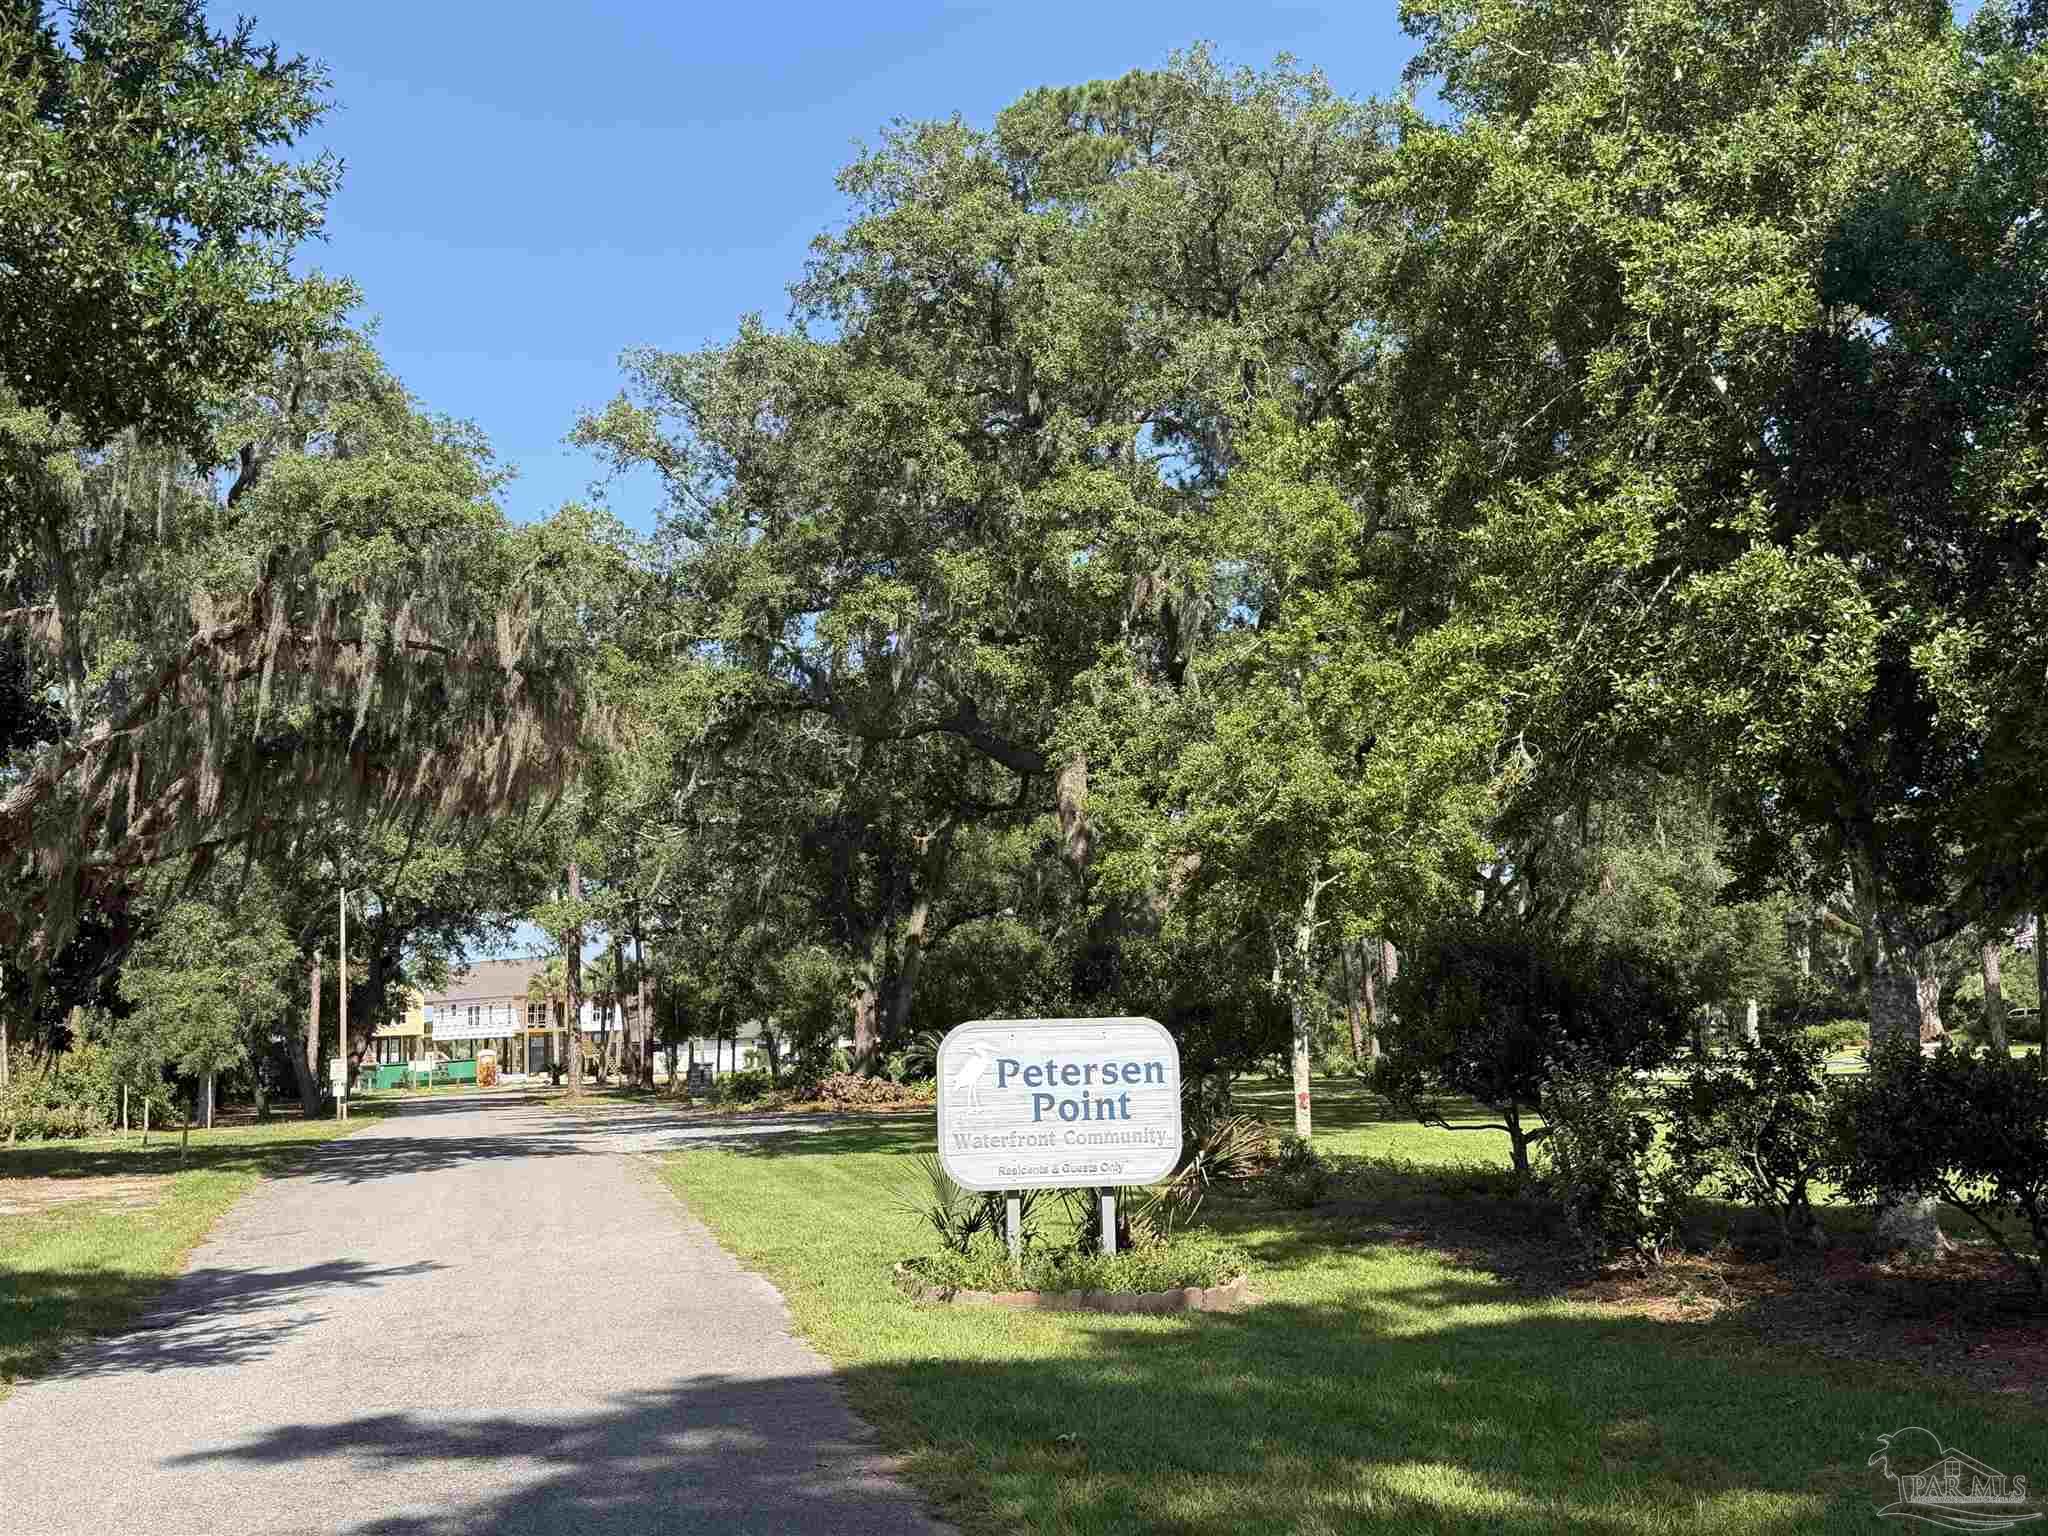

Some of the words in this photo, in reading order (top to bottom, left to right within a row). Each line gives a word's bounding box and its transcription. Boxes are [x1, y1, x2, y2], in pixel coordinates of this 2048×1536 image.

[996, 1058, 1165, 1088] Petersen
[1032, 1091, 1131, 1122] Point
[952, 1131, 1056, 1150] Waterfront
[1064, 1127, 1169, 1147] Community
